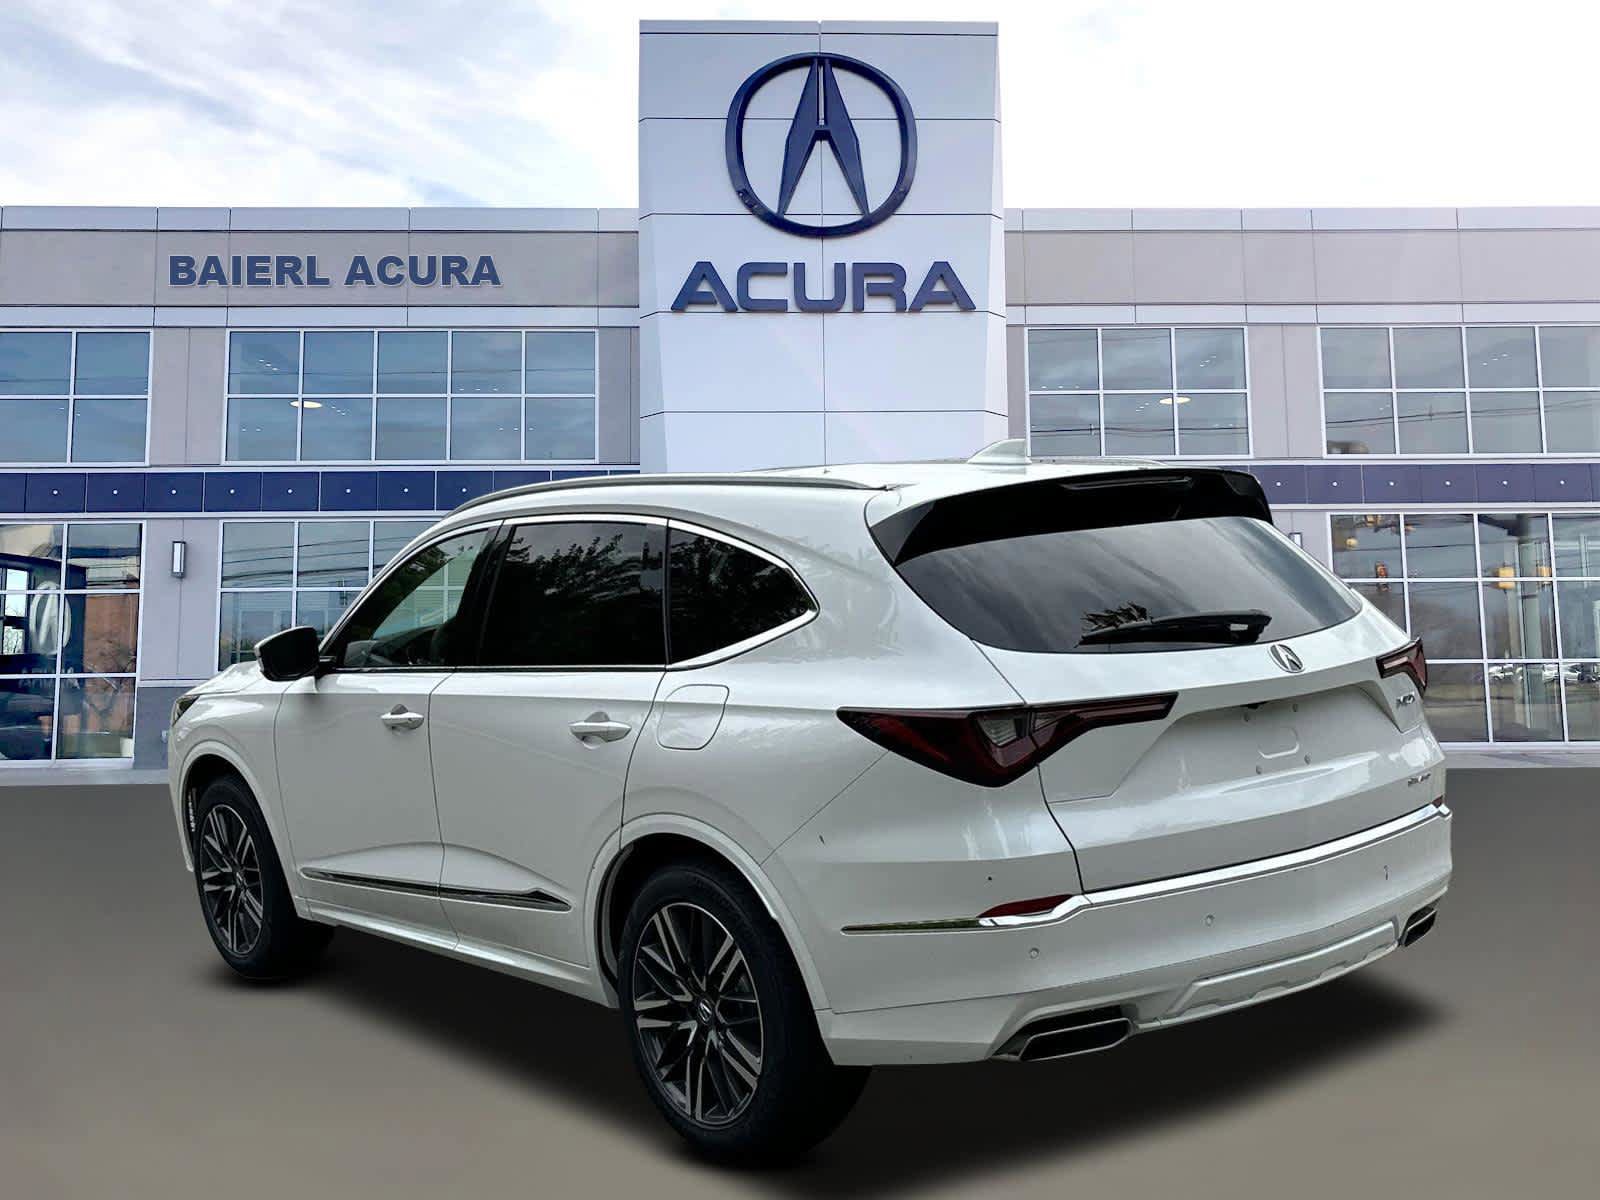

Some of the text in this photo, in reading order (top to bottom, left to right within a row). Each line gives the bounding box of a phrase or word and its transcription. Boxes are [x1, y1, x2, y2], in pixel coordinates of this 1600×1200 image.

[169, 254, 501, 287] BAIERL ACURA
[670, 261, 977, 312] ACURA
